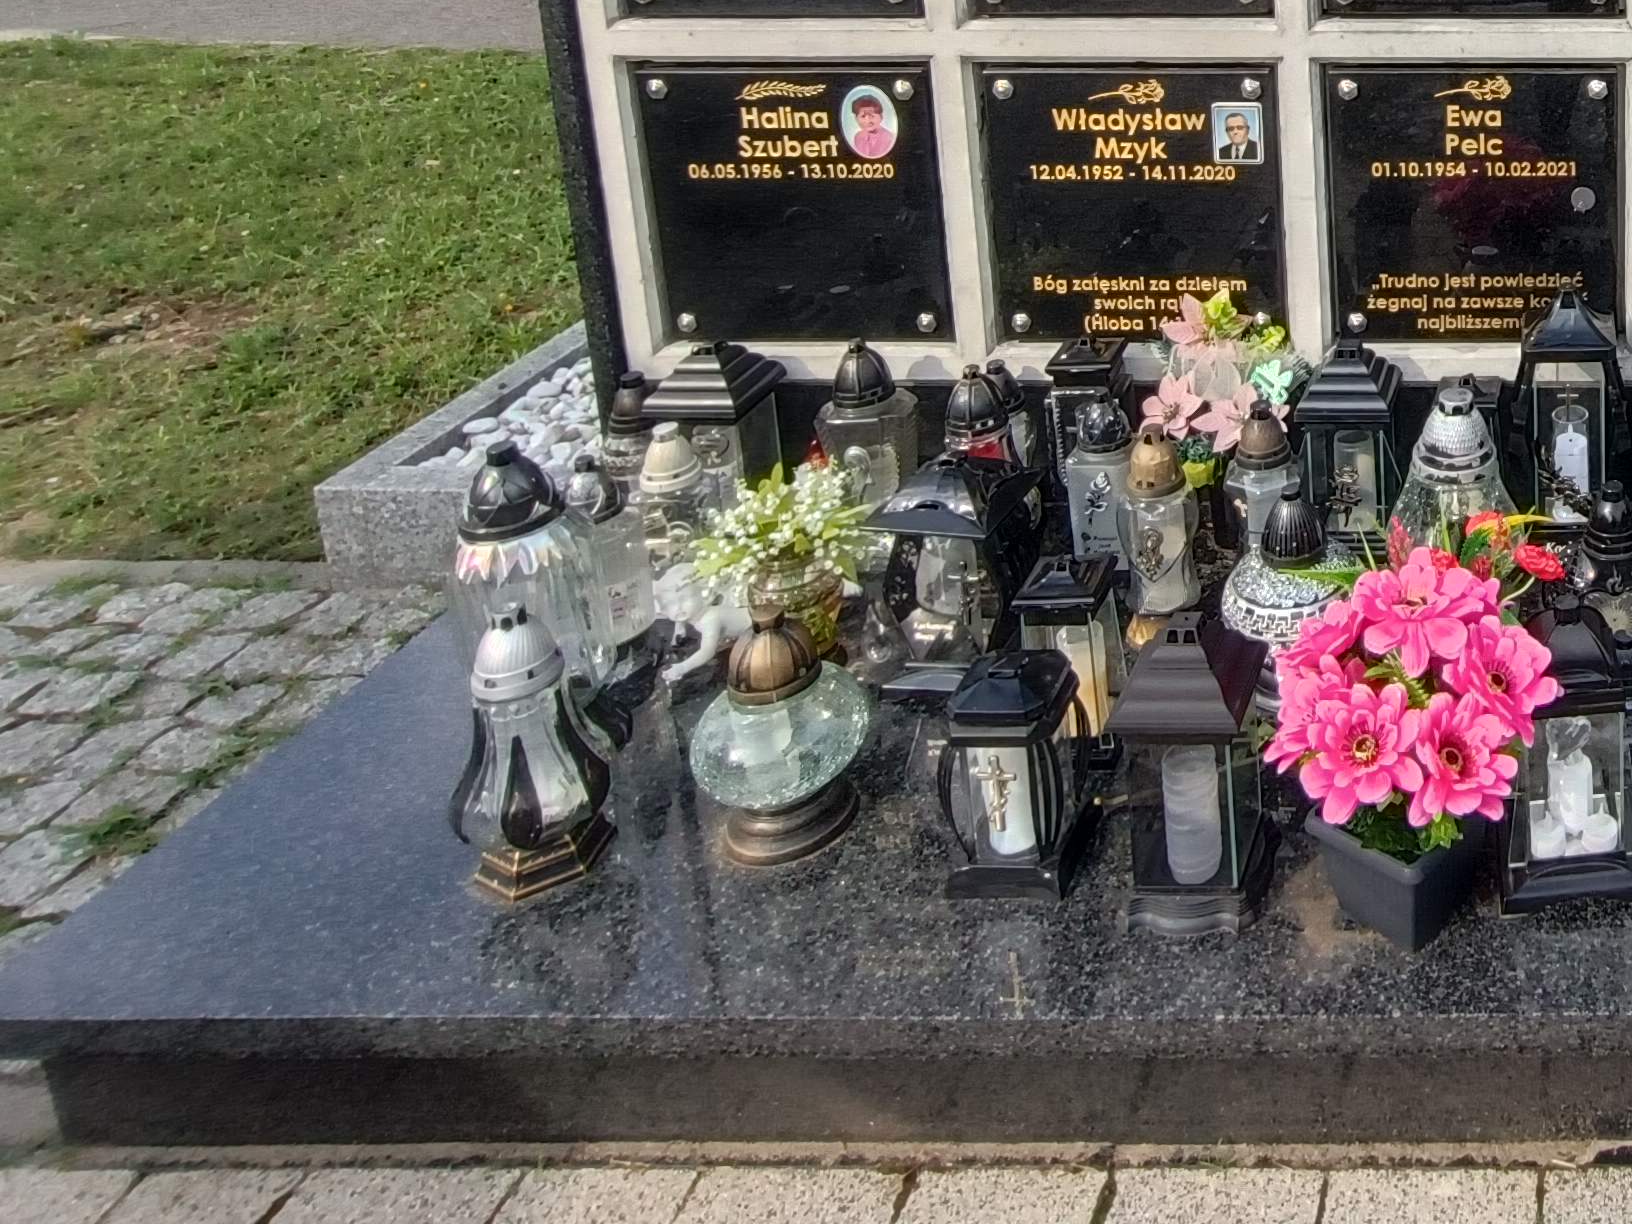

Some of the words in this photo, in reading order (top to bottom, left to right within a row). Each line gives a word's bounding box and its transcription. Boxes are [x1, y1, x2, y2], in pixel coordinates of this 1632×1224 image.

[741, 107, 828, 128] Halina
[1052, 108, 1205, 135] Władysław
[1447, 105, 1501, 126] Ewa
[739, 135, 838, 157] Szubert
[1095, 137, 1167, 164] Mzyk
[1446, 133, 1503, 155] Pelc
[688, 164, 782, 178] 06.05.1956
[801, 163, 893, 178] 13.10.2020
[1030, 165, 1123, 180] 12.04.1952
[1142, 165, 1235, 180] 14.11.2020
[1372, 162, 1466, 177] 01.10.1954
[1485, 162, 1575, 176] 10.02.2021
[1033, 275, 1067, 294] Bóg
[1072, 277, 1144, 294] zatęskni
[1150, 280, 1170, 291] za
[1175, 277, 1247, 292] dziełem
[1444, 273, 1475, 291] jest
[1480, 271, 1583, 292] powiedzieć
[1094, 296, 1155, 309] swoich
[1367, 294, 1427, 312] żegnaj
[1433, 298, 1455, 308] na
[1461, 297, 1524, 308] zawsze
